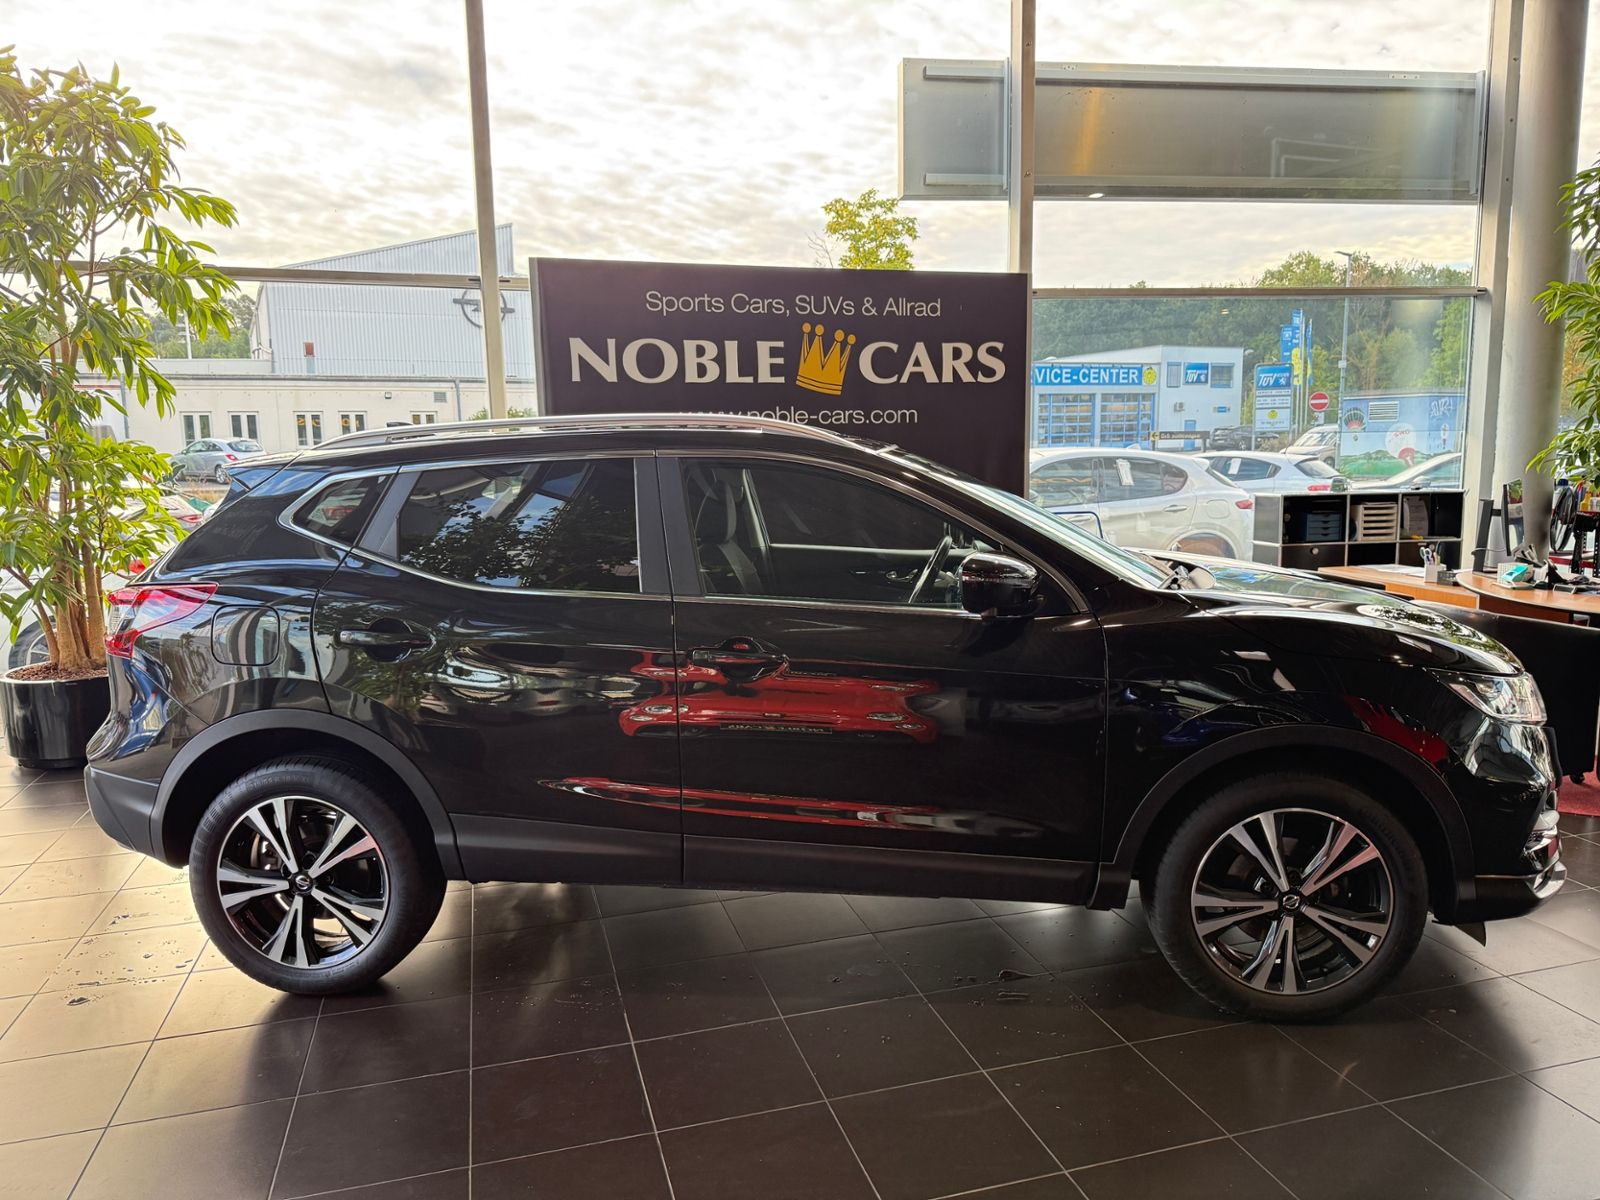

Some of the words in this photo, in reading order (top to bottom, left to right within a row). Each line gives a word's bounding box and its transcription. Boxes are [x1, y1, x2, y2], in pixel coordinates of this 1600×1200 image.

[645, 290, 725, 317] Sports
[730, 292, 790, 318] Cars,
[795, 294, 855, 316] SUVs
[861, 296, 878, 316] &
[882, 297, 941, 317] Allrad
[568, 337, 786, 384] NOBLE
[857, 340, 1006, 385] CARS
[1032, 367, 1138, 383] VICE-CENTER
[679, 405, 919, 425] oble-cars.com
